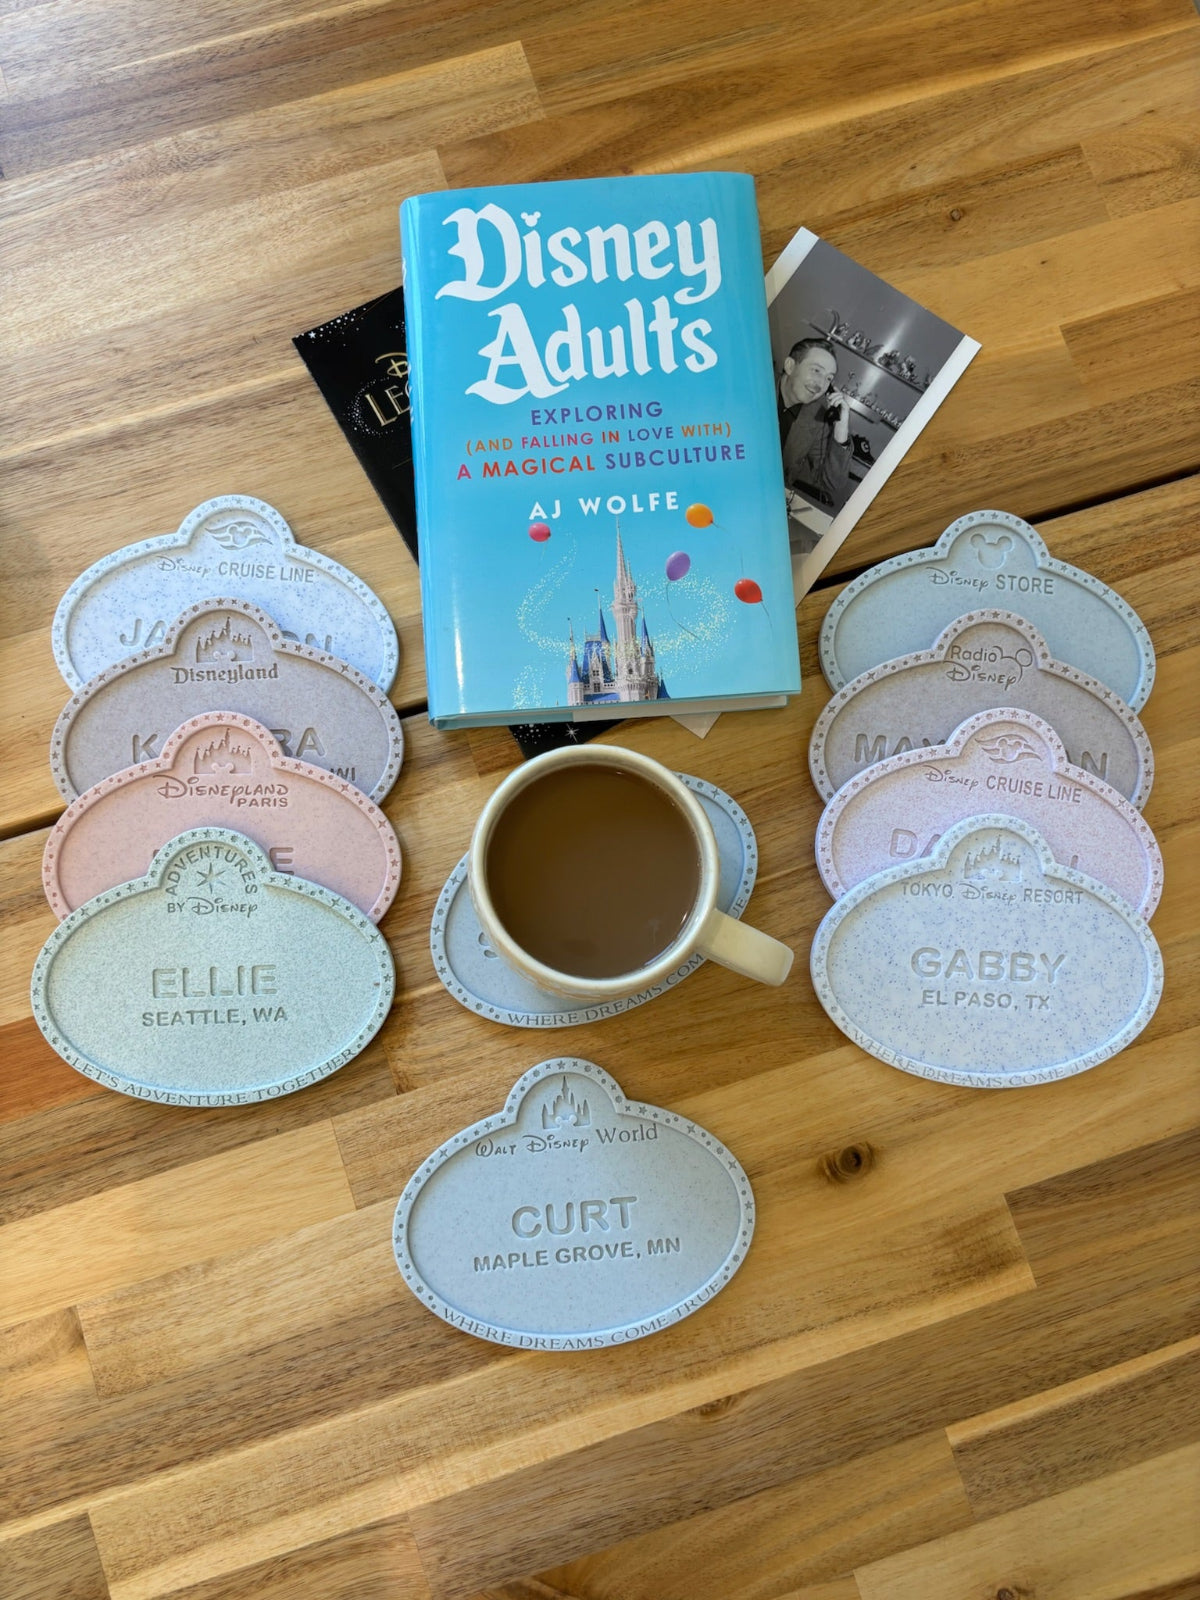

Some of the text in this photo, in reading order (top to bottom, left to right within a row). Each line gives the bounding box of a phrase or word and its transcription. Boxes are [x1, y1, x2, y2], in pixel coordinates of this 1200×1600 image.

[434, 202, 723, 306] Disney
[464, 297, 719, 405] Adults
[530, 401, 664, 426] EXPLORING
[465, 421, 732, 457] (AND FALLING IN LOVE WITH)
[456, 443, 746, 481] A MAGICAL SUBCULTURE
[528, 491, 680, 521] AJ WOLFE
[217, 561, 275, 580] CRUISE
[279, 568, 315, 584] LINE
[995, 574, 1055, 596] STORE
[950, 645, 998, 663] Radio
[170, 663, 279, 685] Disneyland
[236, 797, 289, 808] PARIS
[986, 775, 1044, 798] CRUISE
[1048, 784, 1082, 804] LINE
[164, 844, 259, 896] ADVENTURES
[166, 902, 185, 914] BY
[902, 882, 953, 898] TOKYO
[1023, 888, 1084, 905] RESORT
[151, 963, 277, 998] ELLIE
[910, 946, 1066, 984] GABBY
[508, 952, 705, 1027] WHERE DREAMS COM
[921, 989, 1050, 1010] EL PASO, TX
[141, 1006, 288, 1026] SEATTLE, WA
[853, 1029, 1121, 1088] WHERE DREAMS COME TRUE
[70, 1048, 356, 1107] LET'S ADVENTURE TOGETHER
[595, 1122, 659, 1146] World
[511, 1195, 638, 1239] CURT
[473, 1236, 681, 1272] MAPLE GROVE, MN
[442, 1280, 724, 1351] WHERE DREAMS COME TRUE
